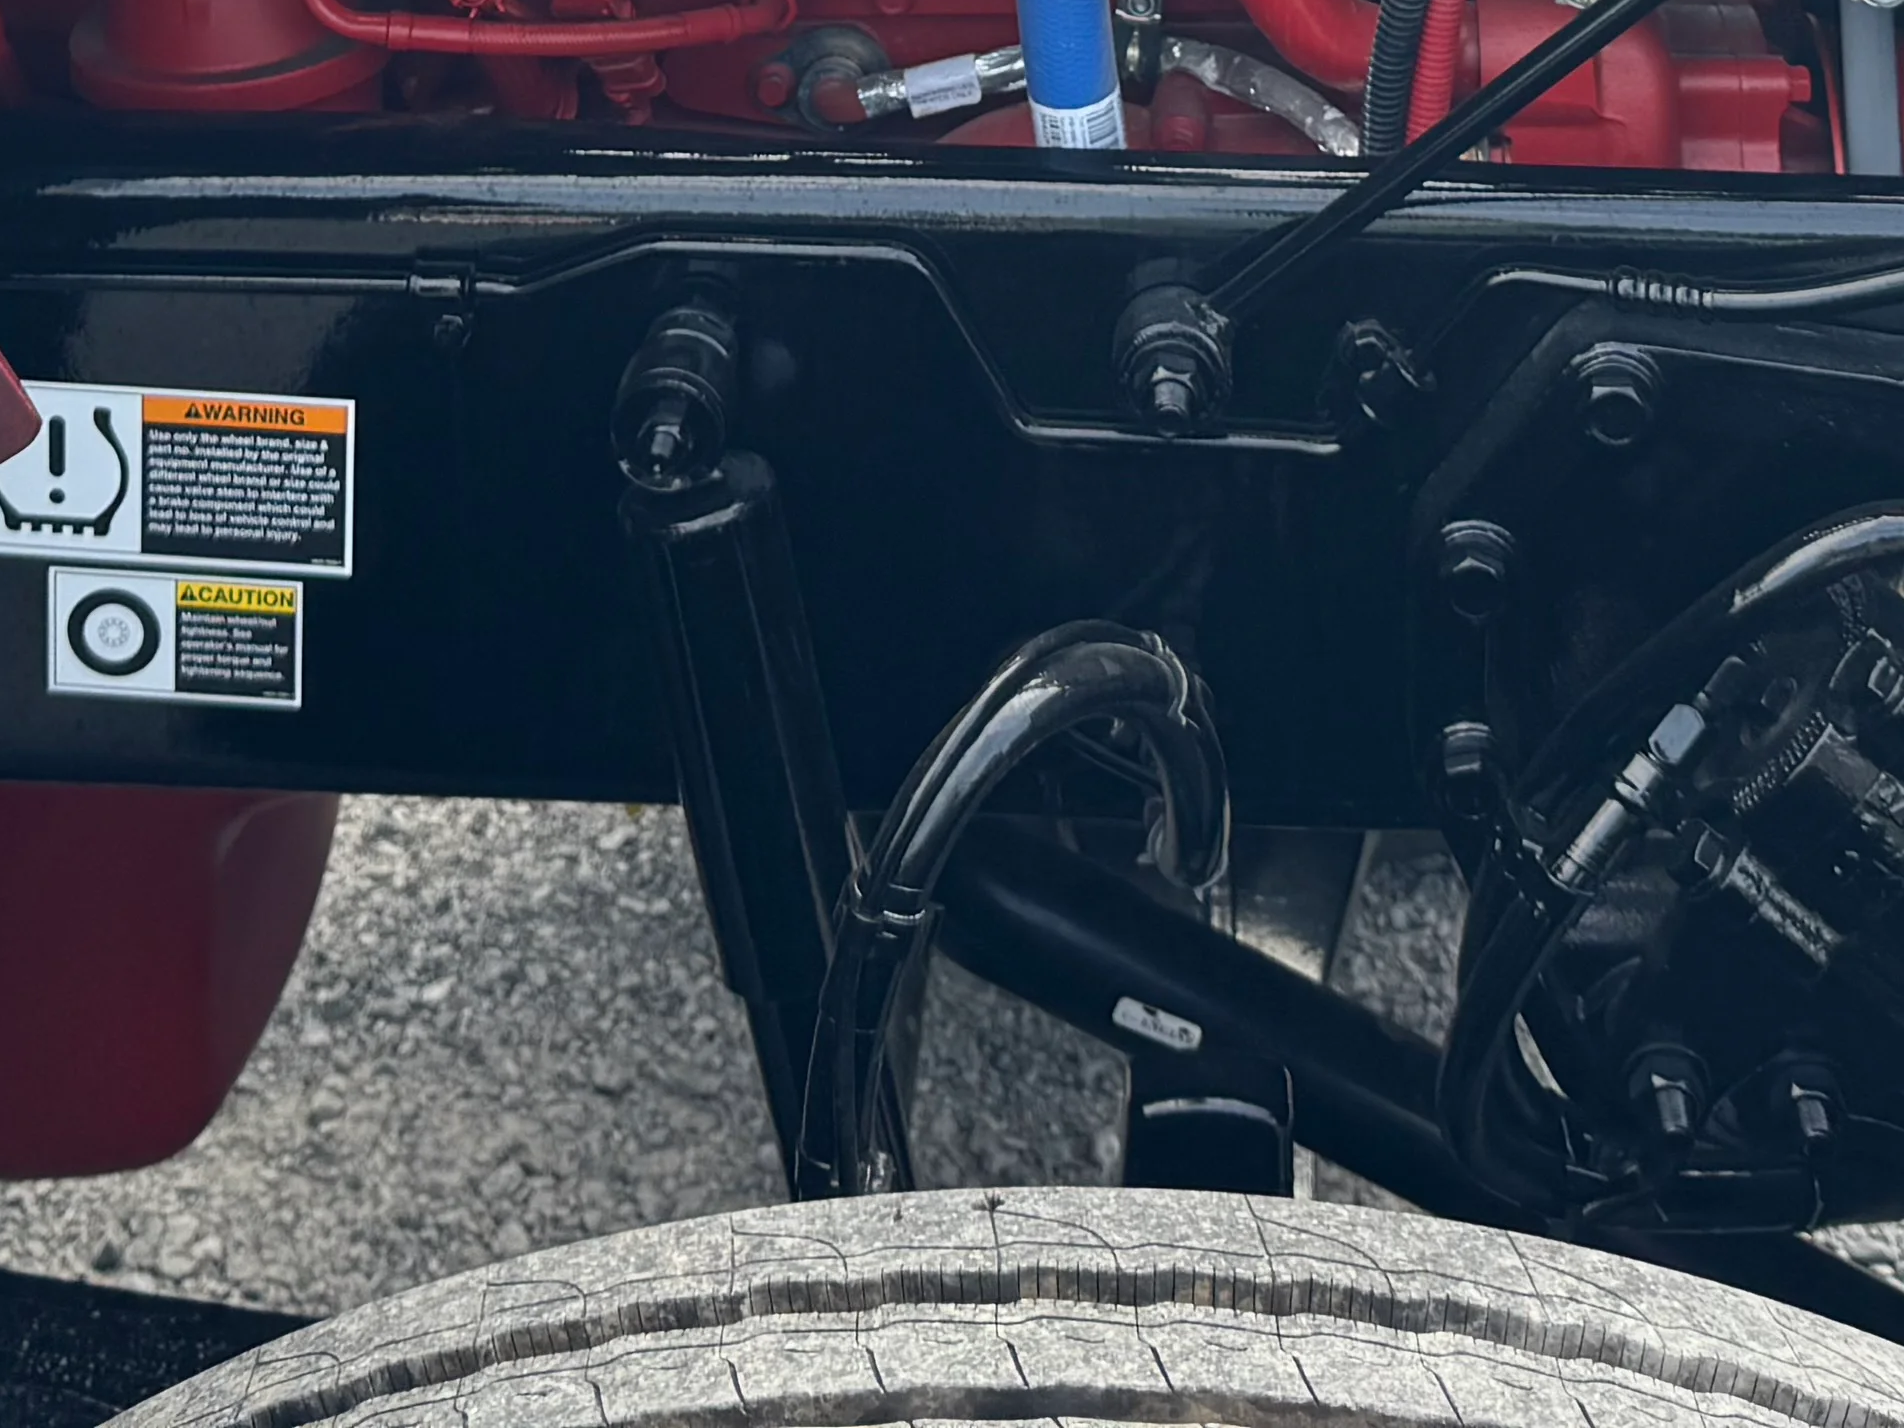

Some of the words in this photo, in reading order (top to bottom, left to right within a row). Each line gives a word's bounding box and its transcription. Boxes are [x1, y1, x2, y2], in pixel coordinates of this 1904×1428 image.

[202, 403, 305, 426] WARNING
[149, 429, 171, 442] Use
[173, 430, 197, 444] only
[200, 432, 219, 444] the
[221, 433, 255, 446] wheel
[295, 438, 318, 450] size
[149, 444, 171, 456] part
[195, 445, 242, 459] installed
[245, 447, 258, 461] by
[261, 449, 279, 461] the
[282, 450, 325, 465] original
[291, 464, 313, 476] Use
[315, 465, 327, 477] of
[197, 585, 294, 607] CAUTION
